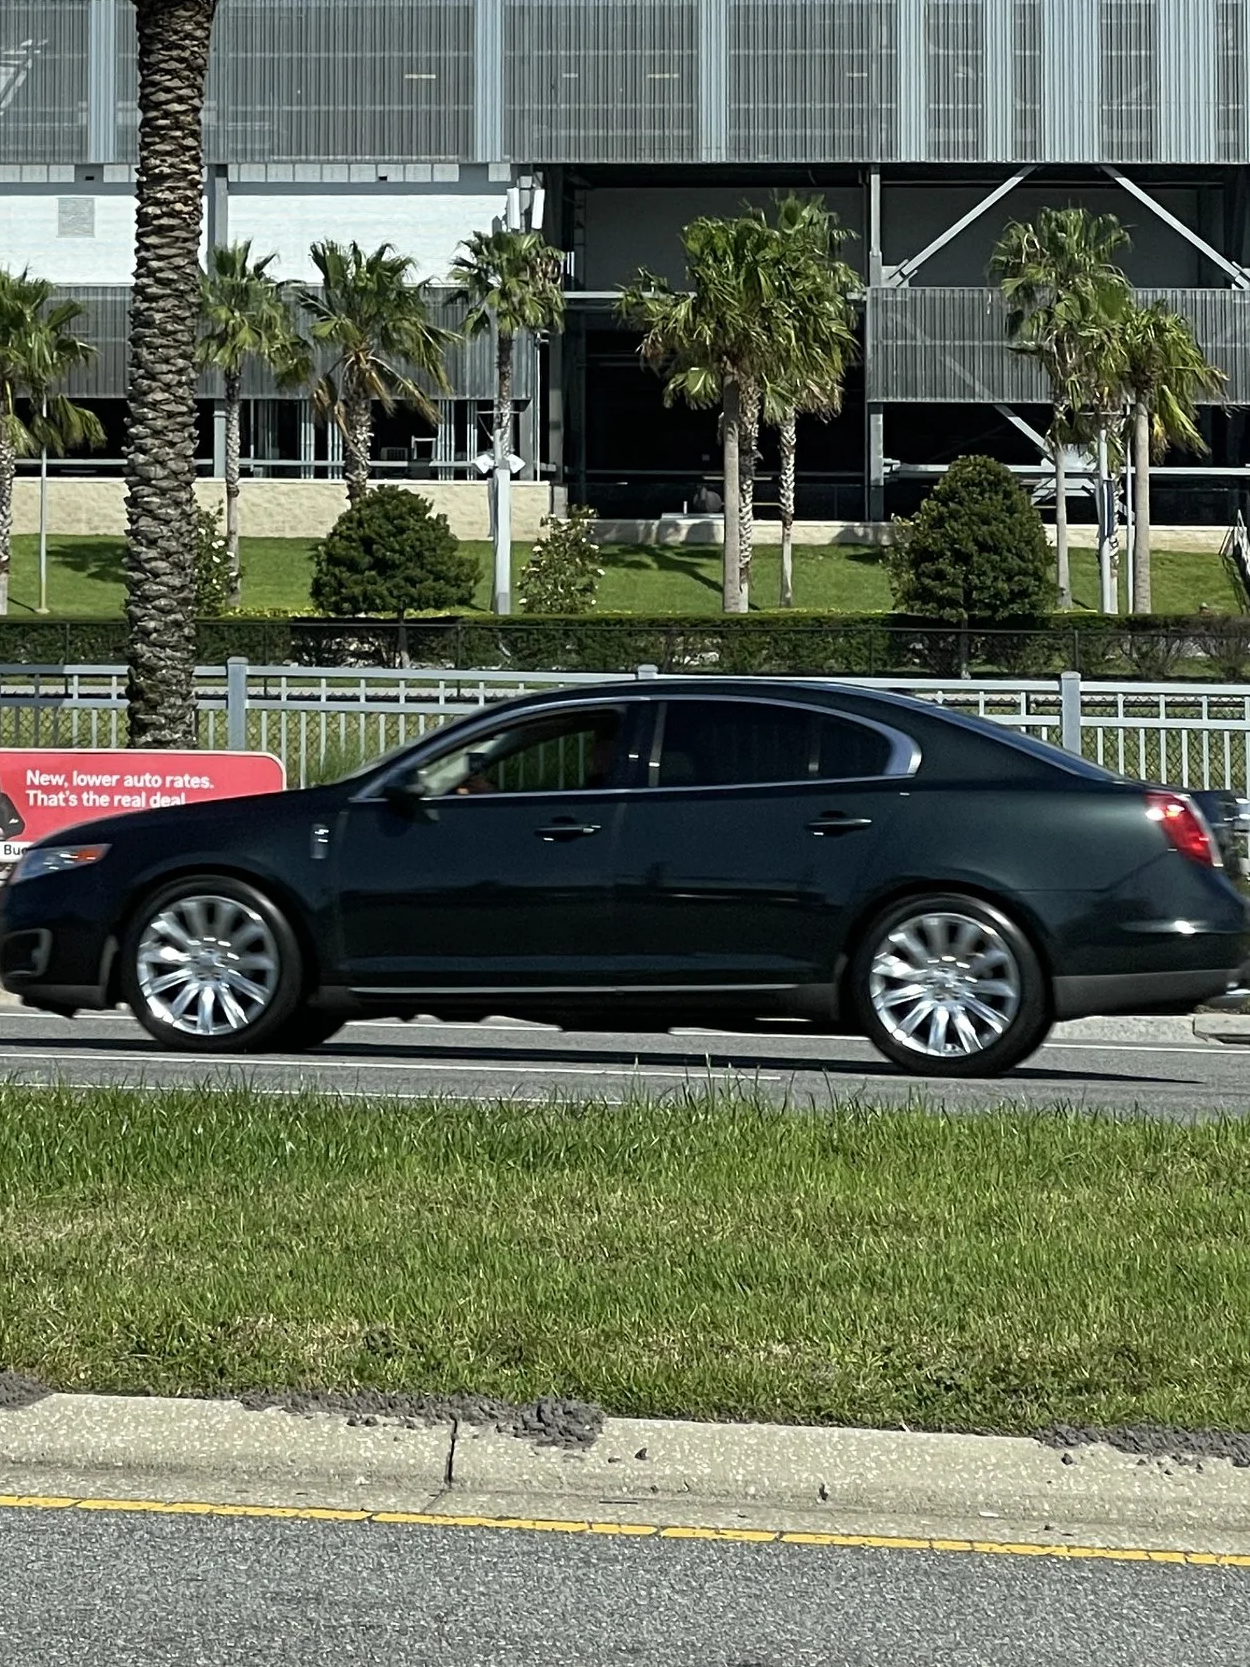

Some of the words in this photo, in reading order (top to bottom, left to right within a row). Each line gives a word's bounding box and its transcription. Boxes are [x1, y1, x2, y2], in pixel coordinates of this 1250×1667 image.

[25, 769, 69, 788] New,
[72, 770, 120, 787] lower
[123, 772, 162, 788] auto
[165, 773, 214, 789] rates.
[25, 789, 78, 806] That's
[81, 790, 111, 807] the
[113, 791, 146, 808] real
